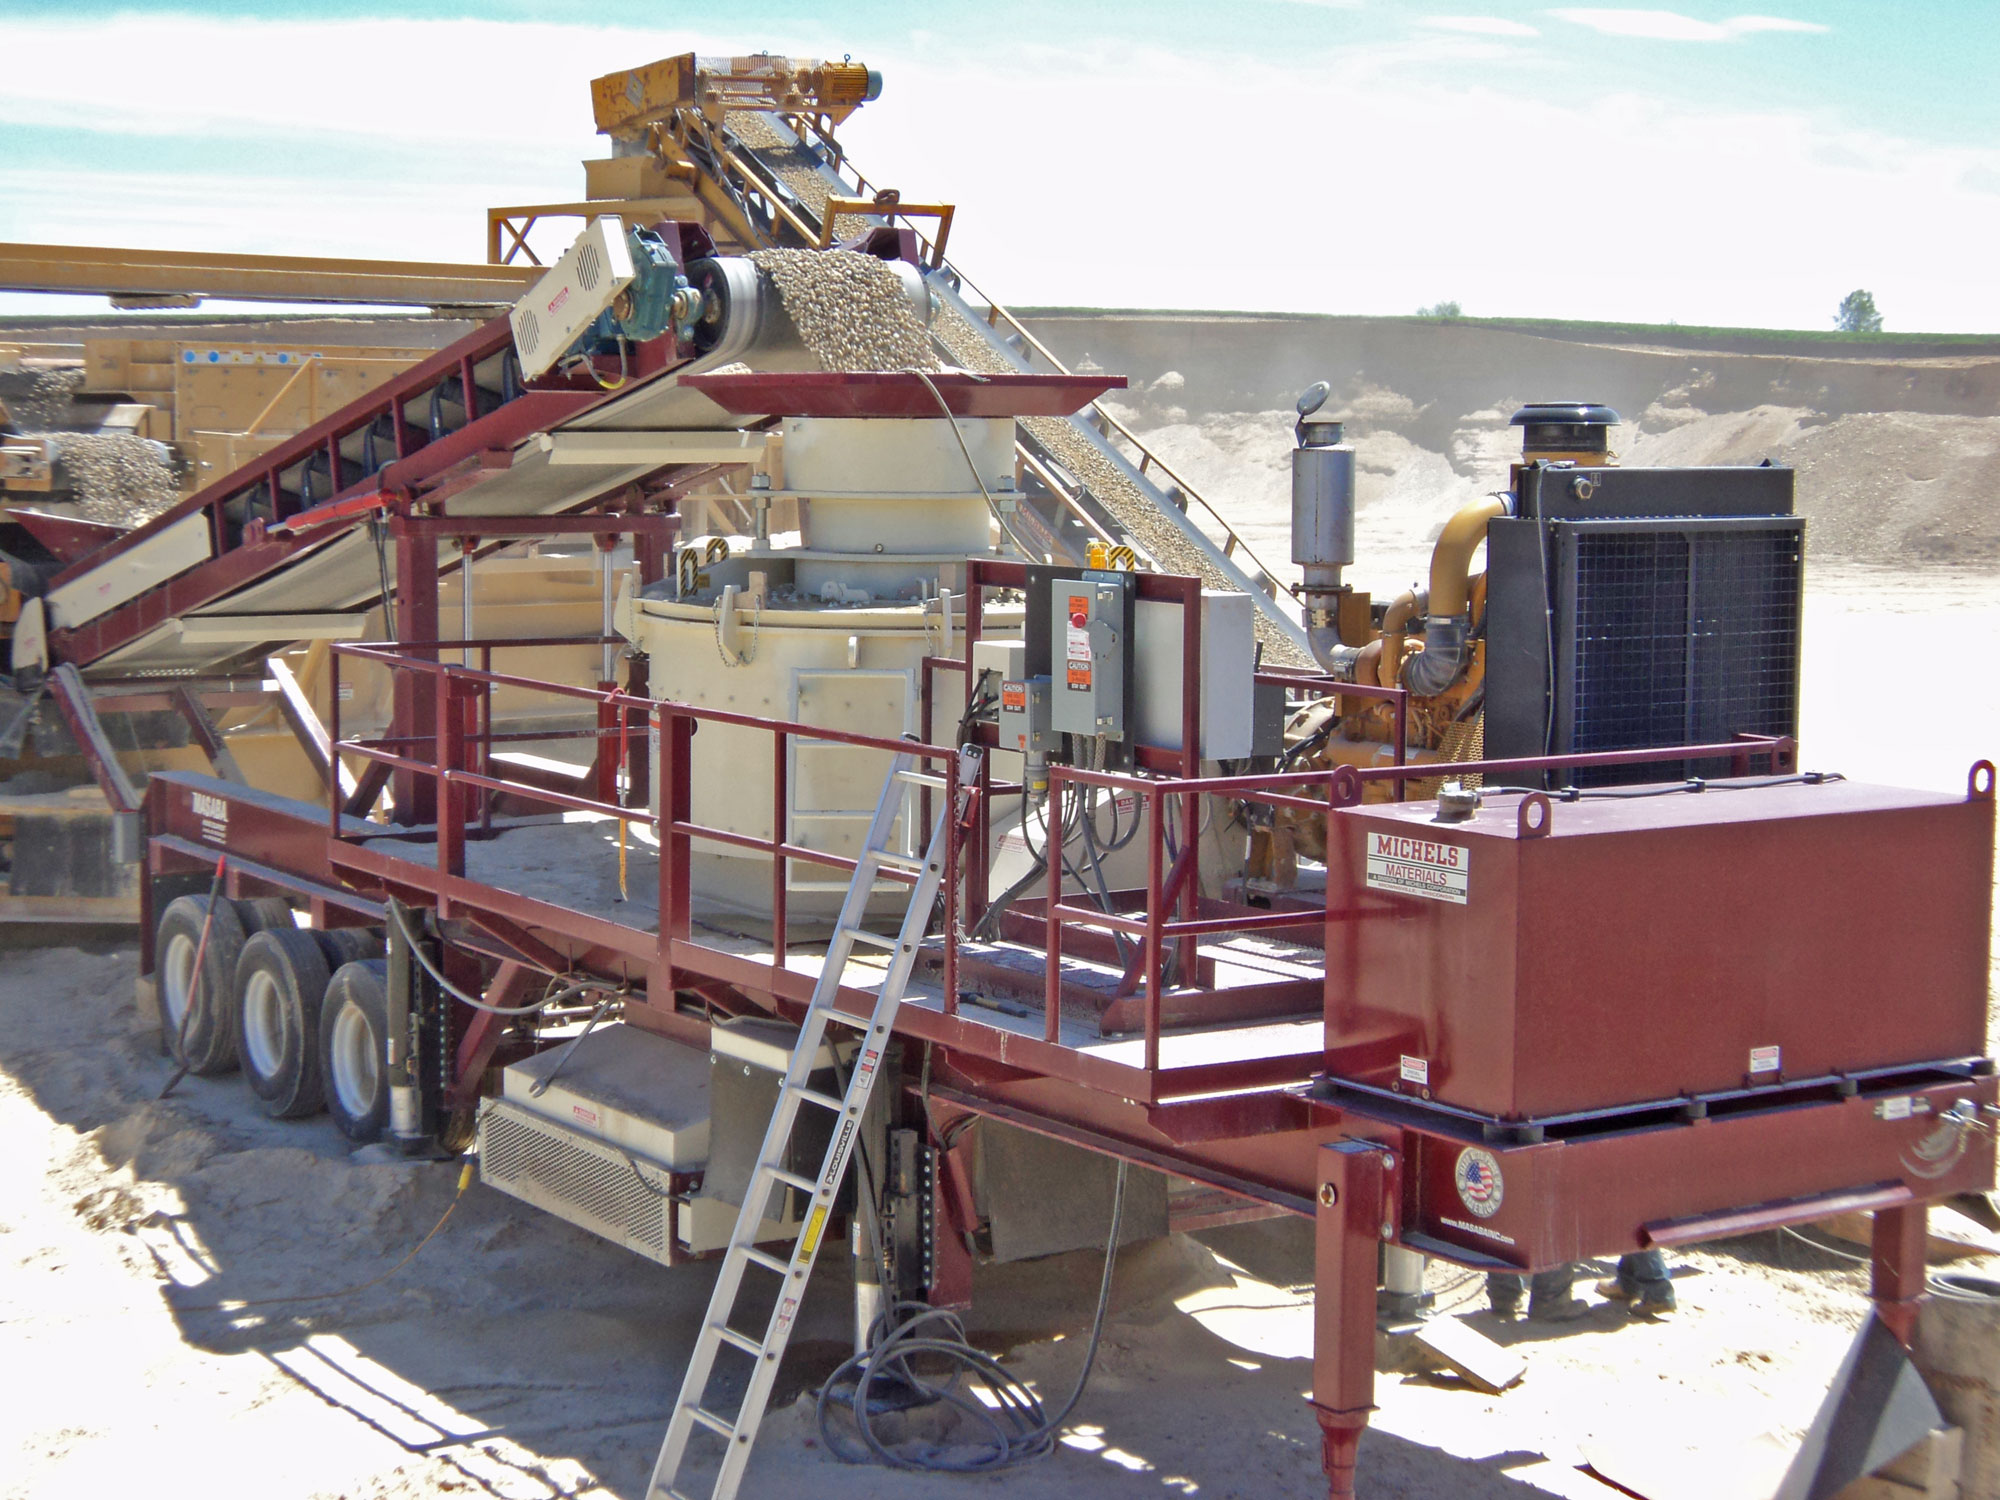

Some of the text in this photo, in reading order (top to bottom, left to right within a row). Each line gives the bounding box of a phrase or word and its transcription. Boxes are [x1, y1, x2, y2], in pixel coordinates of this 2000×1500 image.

[1068, 662, 1090, 670] CAUTION
[1003, 684, 1024, 693] CAUTION
[1376, 835, 1458, 867] MICHELS
[1386, 864, 1447, 886] MATERIALS
[1427, 883, 1461, 894] CORPORATION
[830, 1121, 852, 1176] LOUISVILLE
[1462, 1192, 1496, 1215] AMERICA
[1440, 1216, 1514, 1245] www.MASABAINC.com
